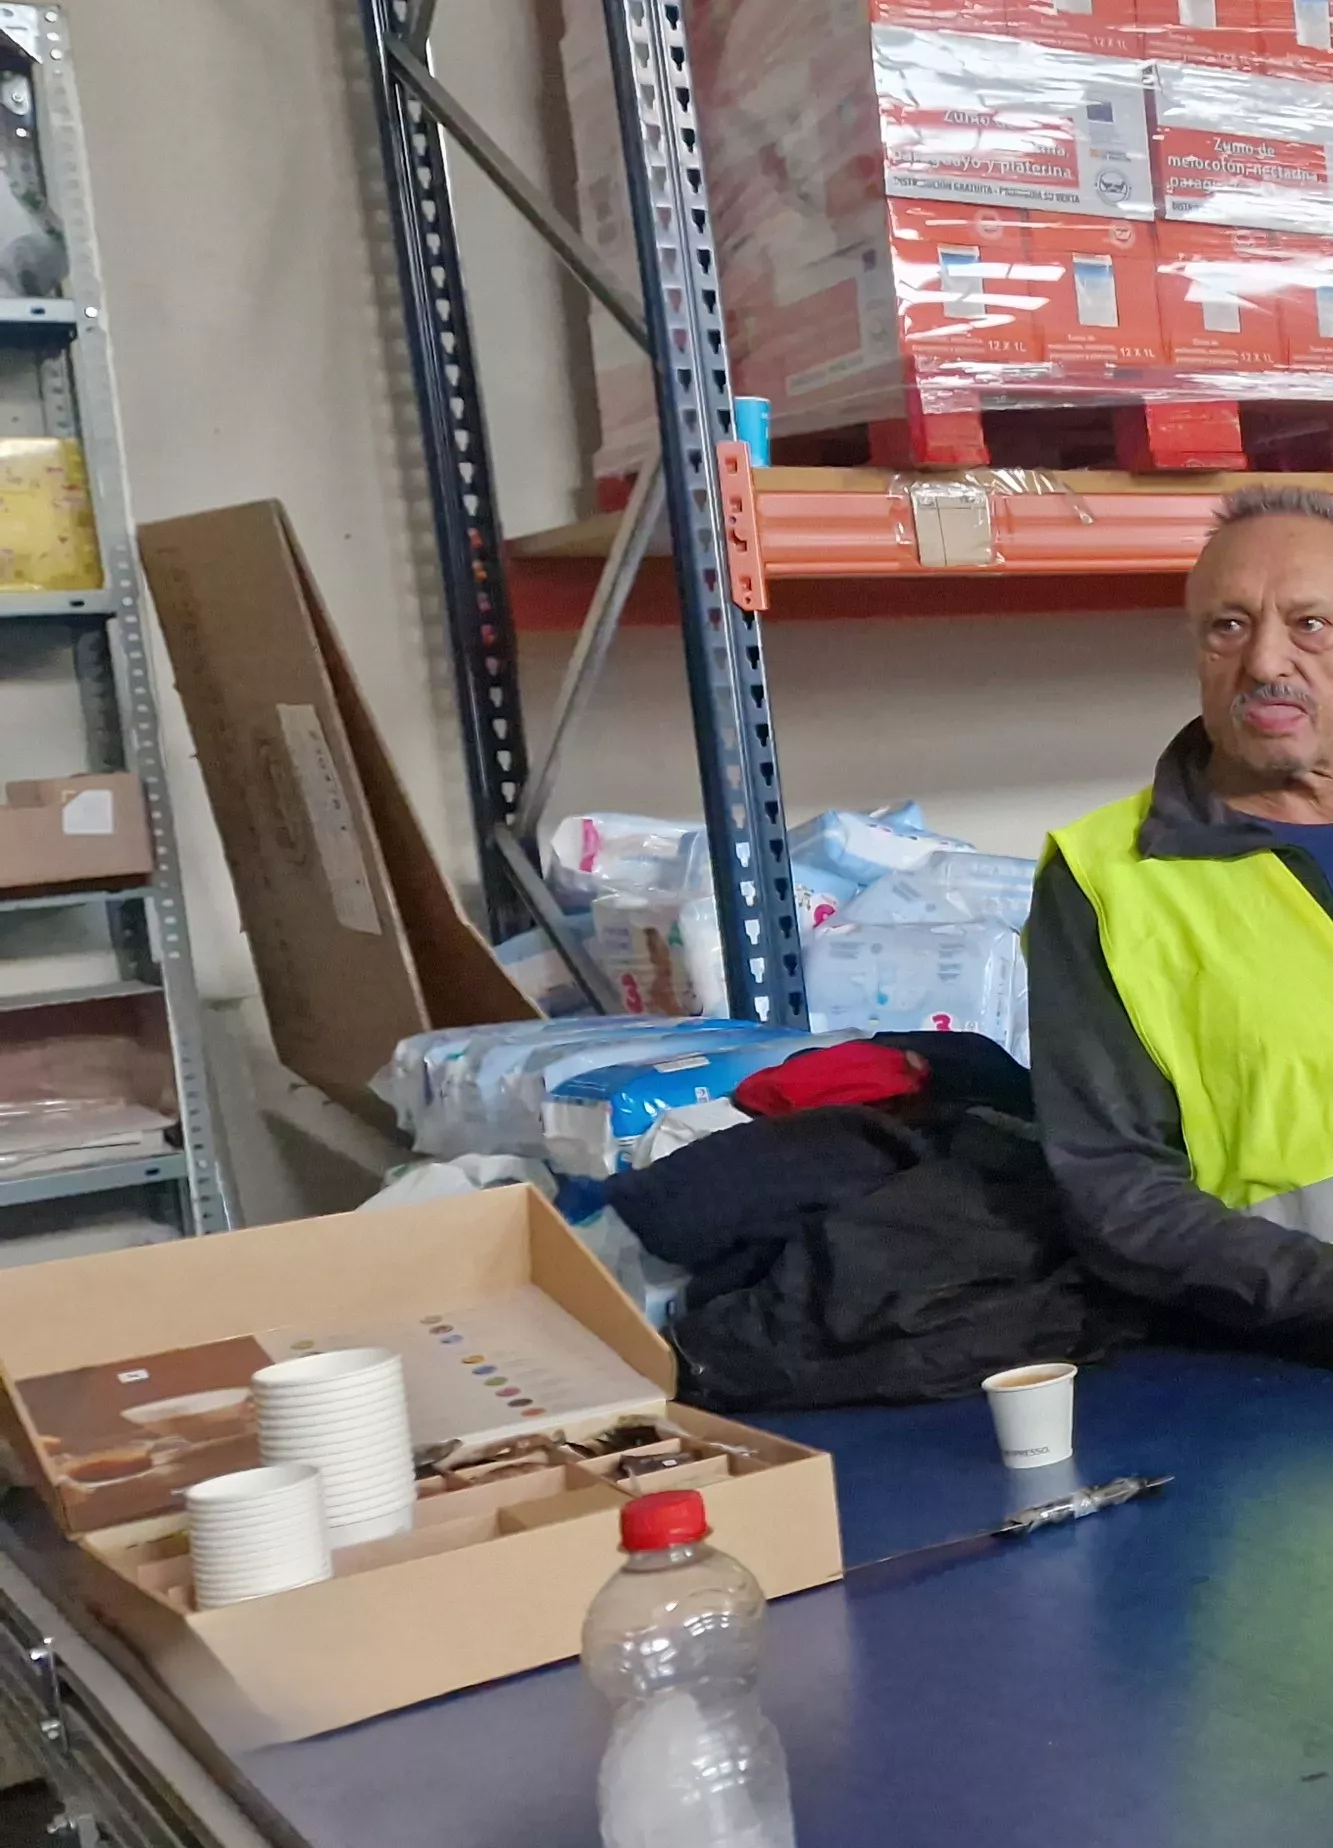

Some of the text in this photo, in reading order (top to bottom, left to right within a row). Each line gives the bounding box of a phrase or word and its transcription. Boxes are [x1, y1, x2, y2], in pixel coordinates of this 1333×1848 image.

[1213, 137, 1277, 159] Zumo de
[988, 340, 1001, 352] 12
[1120, 347, 1132, 357] 12
[620, 973, 643, 1014] 3
